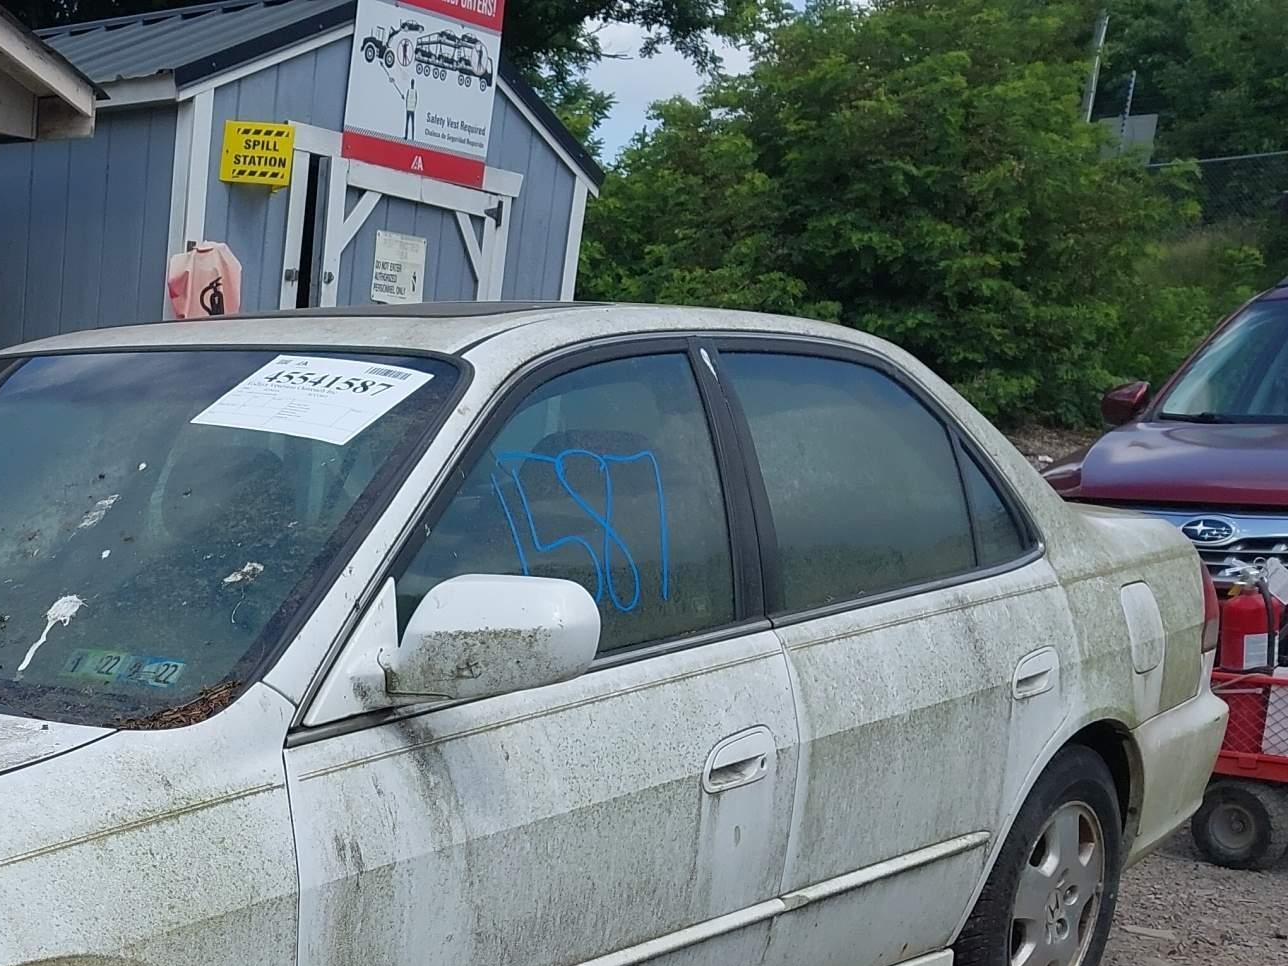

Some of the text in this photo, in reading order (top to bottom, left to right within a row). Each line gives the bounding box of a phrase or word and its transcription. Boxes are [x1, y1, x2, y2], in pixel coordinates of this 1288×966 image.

[426, 112, 446, 128] Safety
[447, 117, 459, 129] Vest
[244, 138, 280, 152] SPILL
[233, 154, 287, 169] STATION
[264, 370, 395, 397] 45541587
[491, 449, 669, 612] 1587
[96, 655, 121, 676] 22
[153, 662, 179, 685] 22
